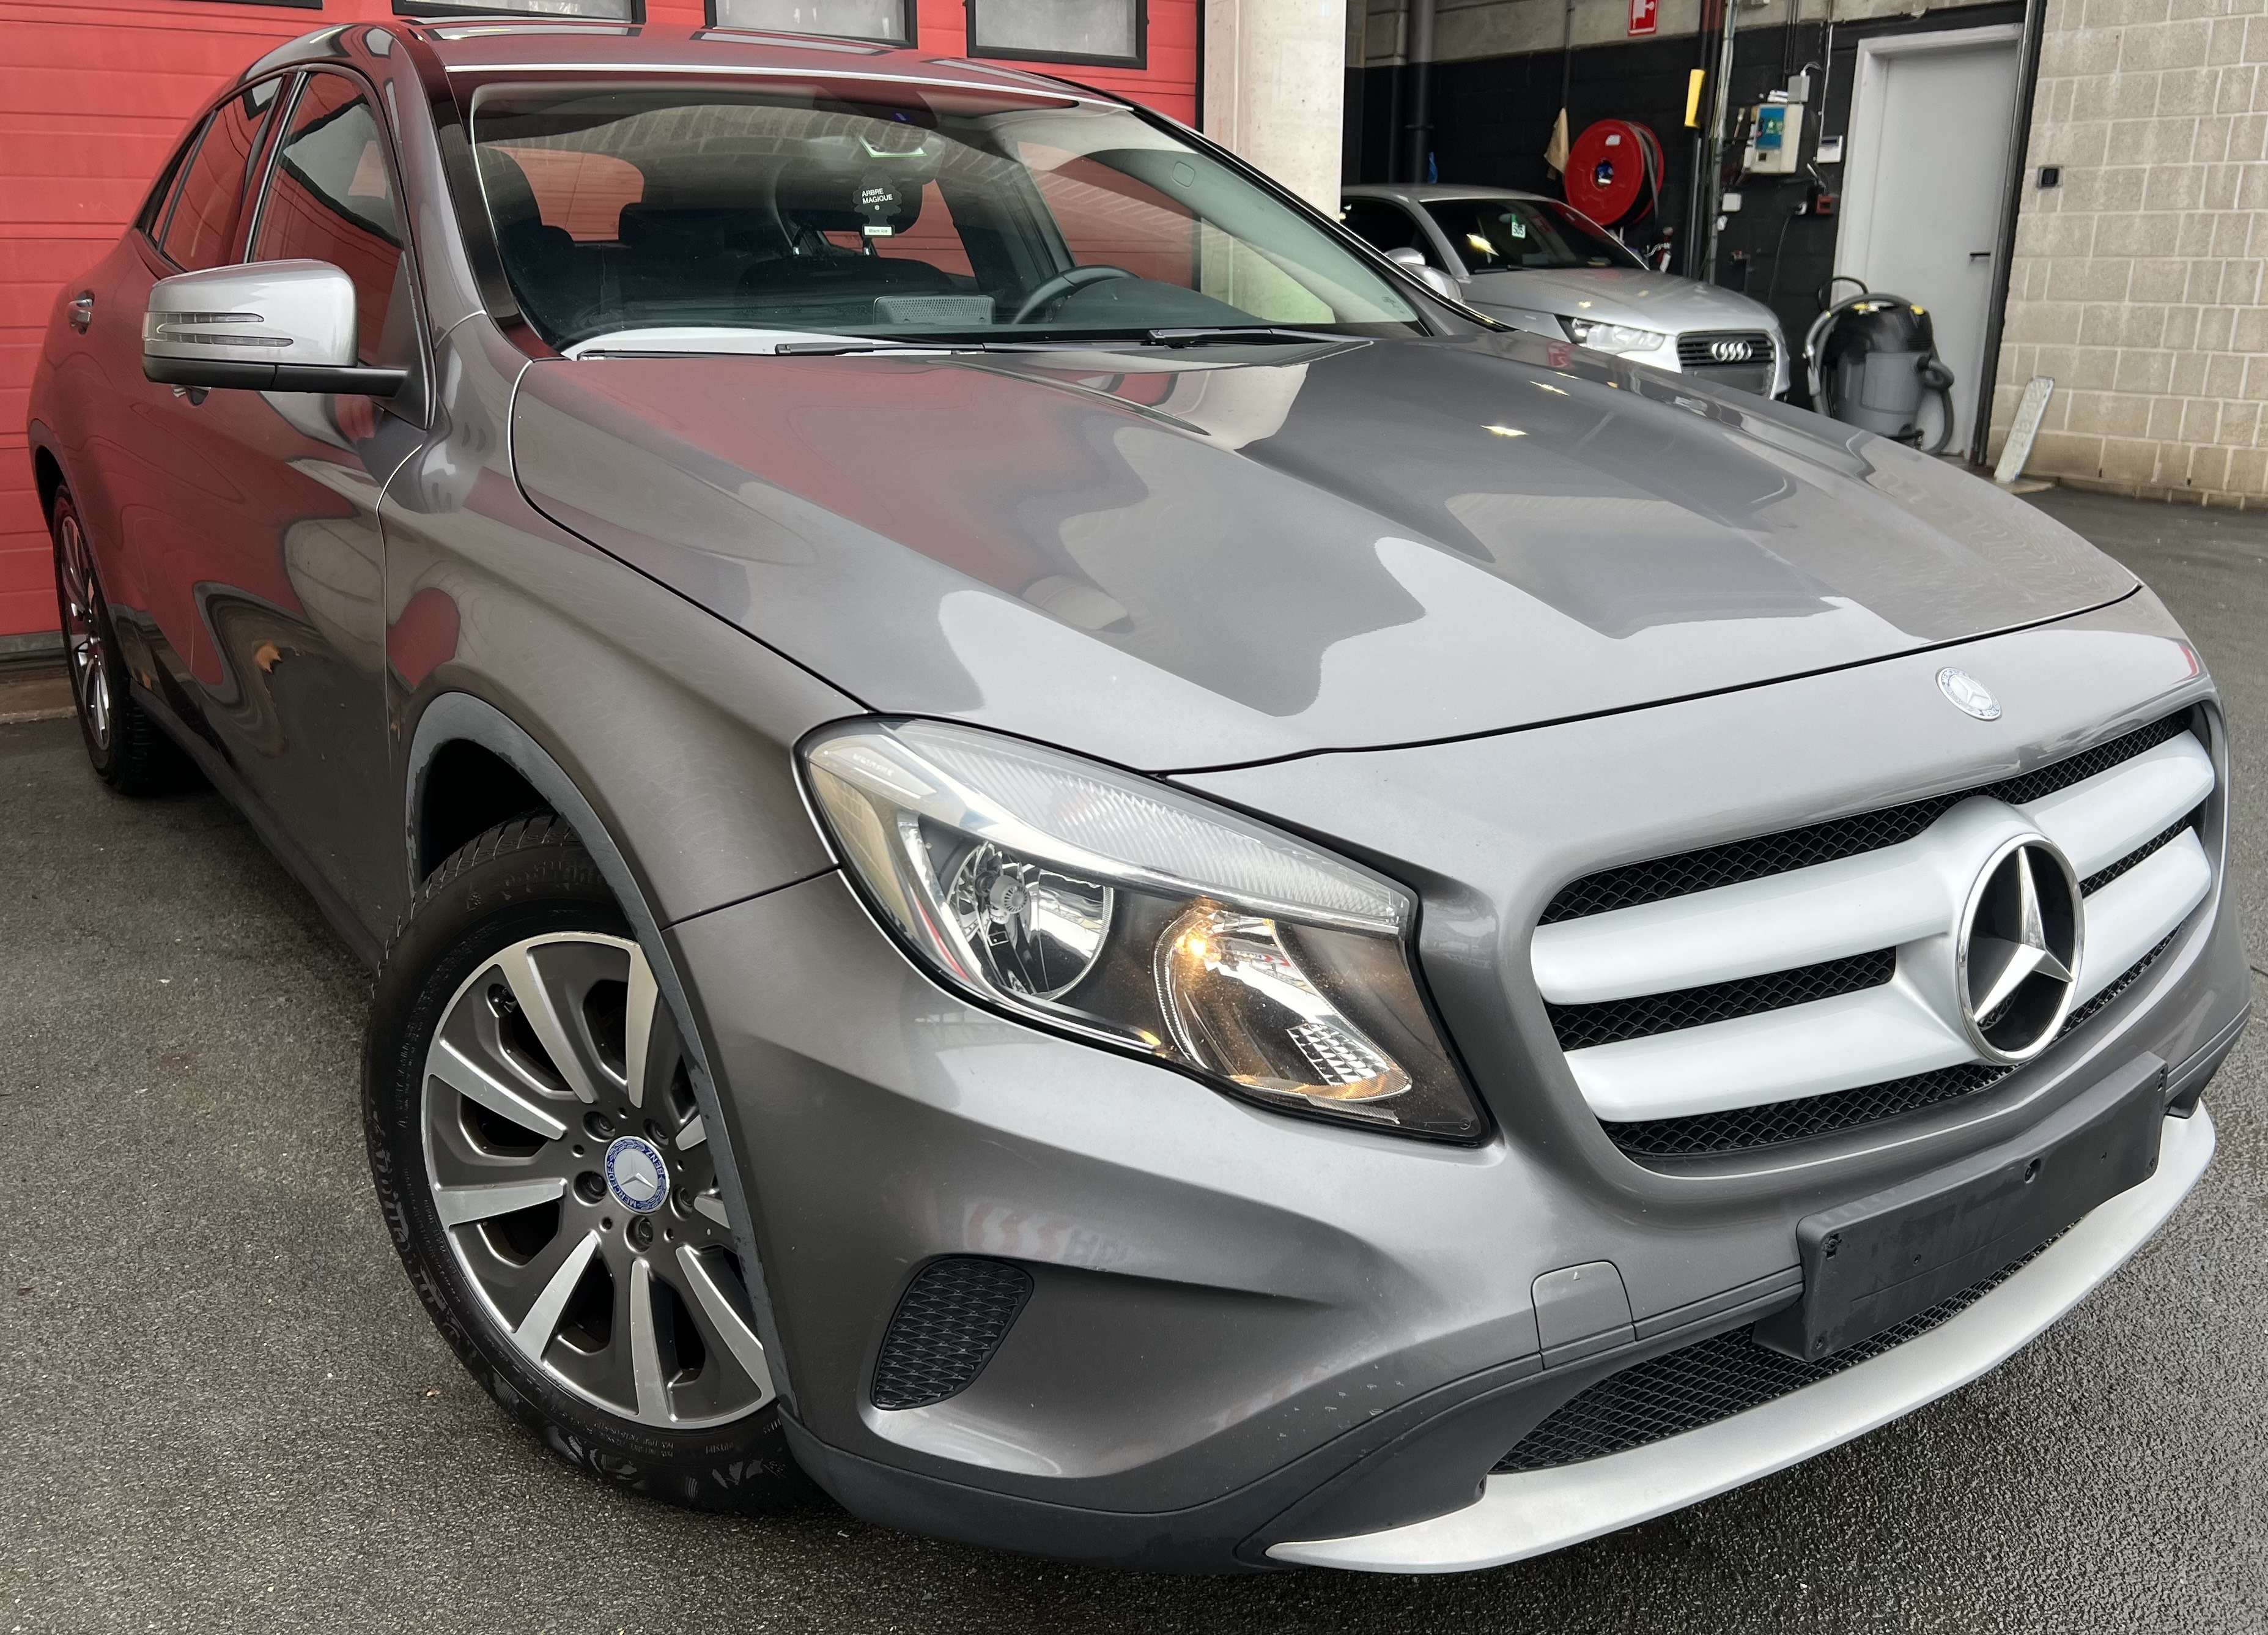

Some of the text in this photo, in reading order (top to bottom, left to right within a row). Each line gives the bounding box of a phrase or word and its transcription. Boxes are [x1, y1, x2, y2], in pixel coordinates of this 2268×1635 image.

[862, 194, 893, 204] MAGIQUE
[645, 1148, 665, 1177] BENZ
[607, 1160, 637, 1208] MERCEDES
